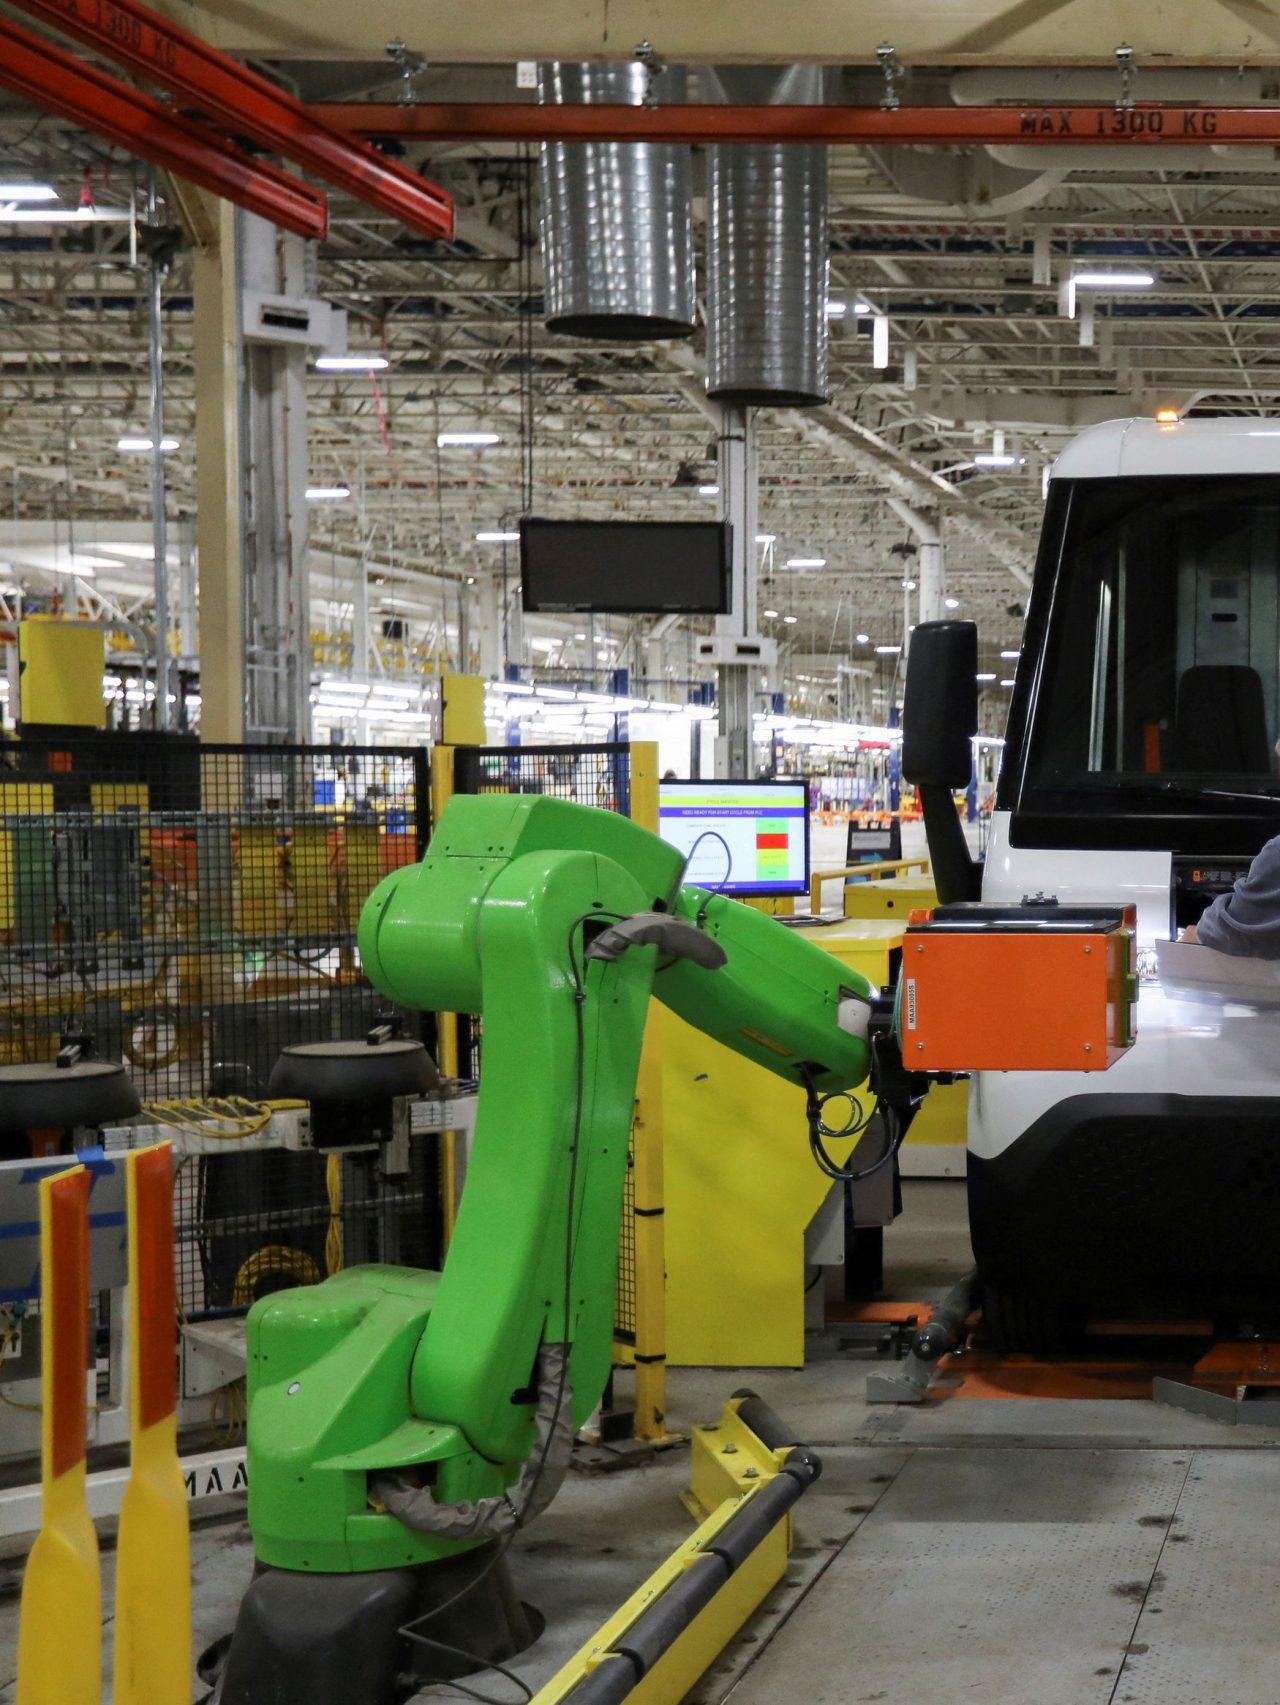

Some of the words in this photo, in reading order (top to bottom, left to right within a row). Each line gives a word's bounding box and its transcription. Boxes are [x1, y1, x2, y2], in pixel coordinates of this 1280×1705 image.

[1020, 111, 1073, 133] MAX
[1096, 111, 1163, 134] 1300
[1183, 111, 1217, 134] KG
